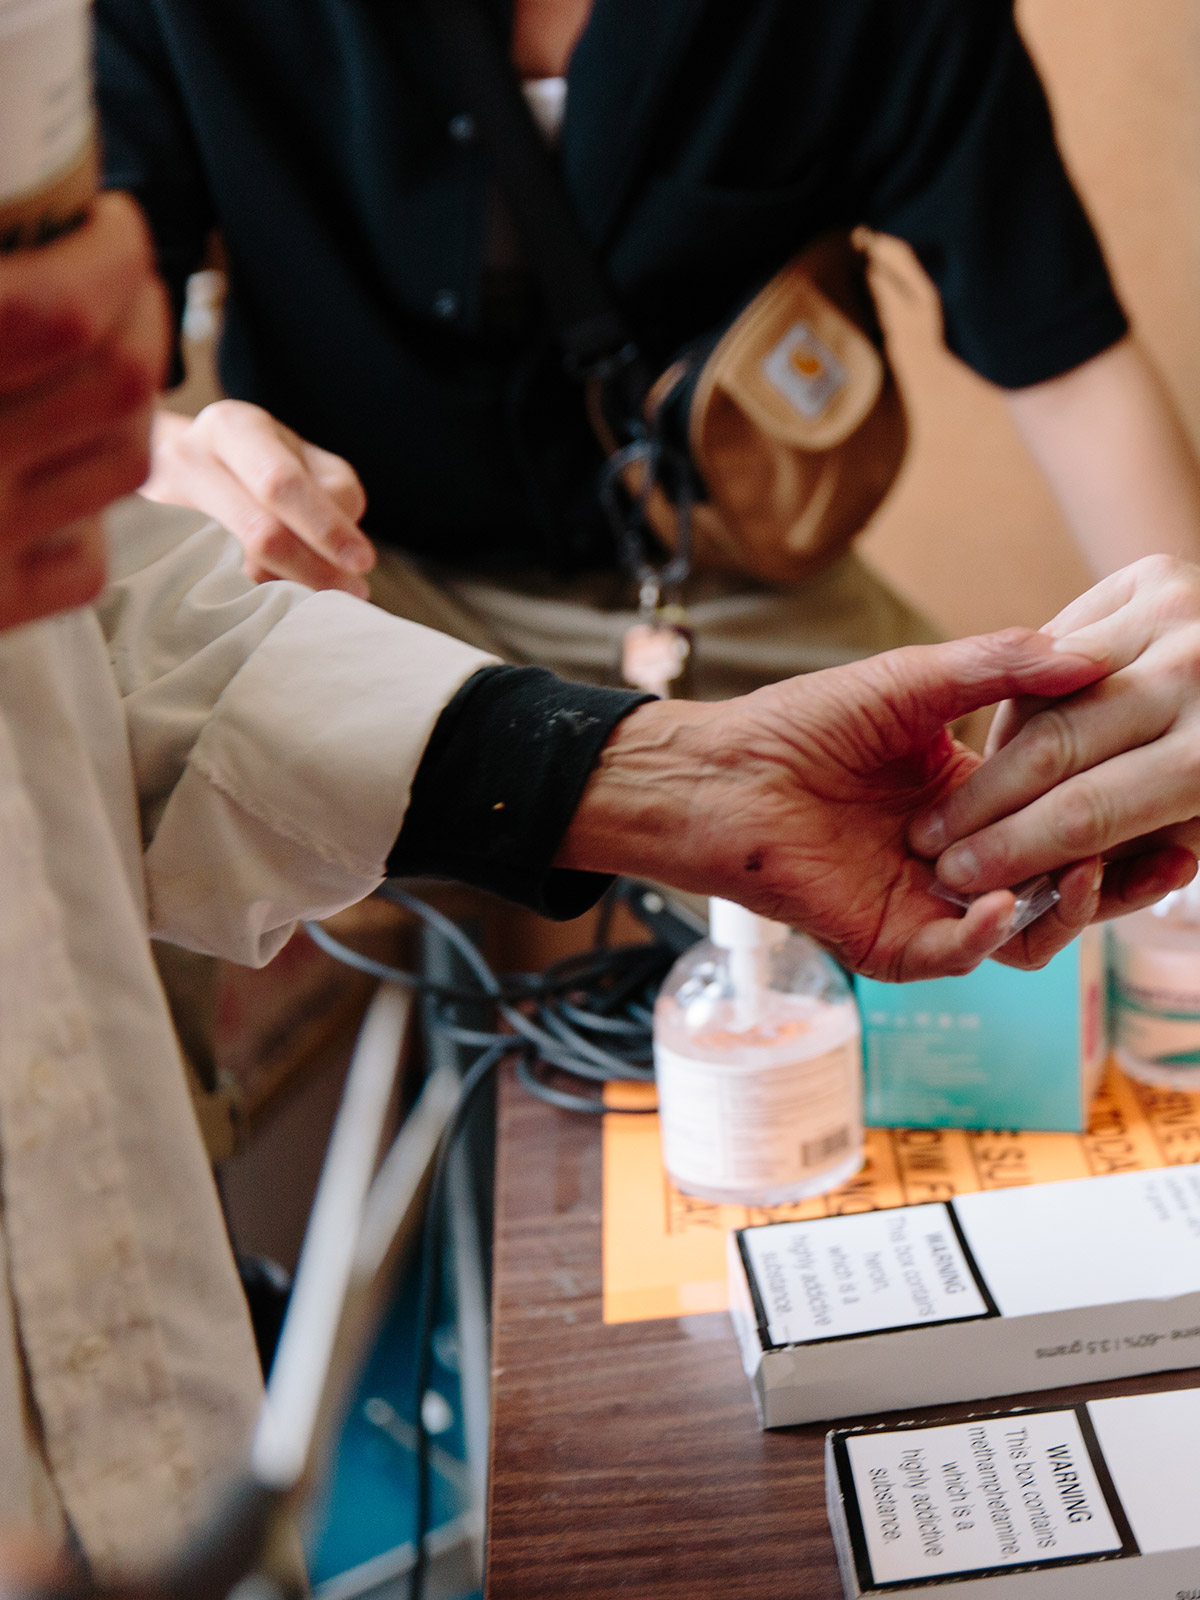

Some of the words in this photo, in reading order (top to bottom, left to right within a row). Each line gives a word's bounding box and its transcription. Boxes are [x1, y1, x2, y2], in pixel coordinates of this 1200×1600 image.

[887, 1216, 908, 1243] This
[789, 1233, 815, 1270] highly
[828, 1245, 856, 1281] which
[894, 1245, 916, 1267] box
[926, 1230, 967, 1295] WARNING
[801, 1270, 832, 1327] addictive
[838, 1281, 860, 1295] is
[902, 1268, 937, 1317] contains
[1035, 1338, 1083, 1359] grams
[1085, 1339, 1111, 1355] 3.5
[1004, 1427, 1031, 1461] This
[899, 1448, 931, 1489] highly
[941, 1461, 973, 1503] which
[1013, 1462, 1037, 1490] box
[1046, 1443, 1094, 1525] WARNING
[869, 1467, 902, 1545] substance.
[951, 1503, 976, 1519] is
[968, 1426, 1022, 1559] methamphetamine,
[911, 1492, 945, 1557] addictive
[955, 1519, 975, 1532] a
[1022, 1490, 1057, 1549] contains
